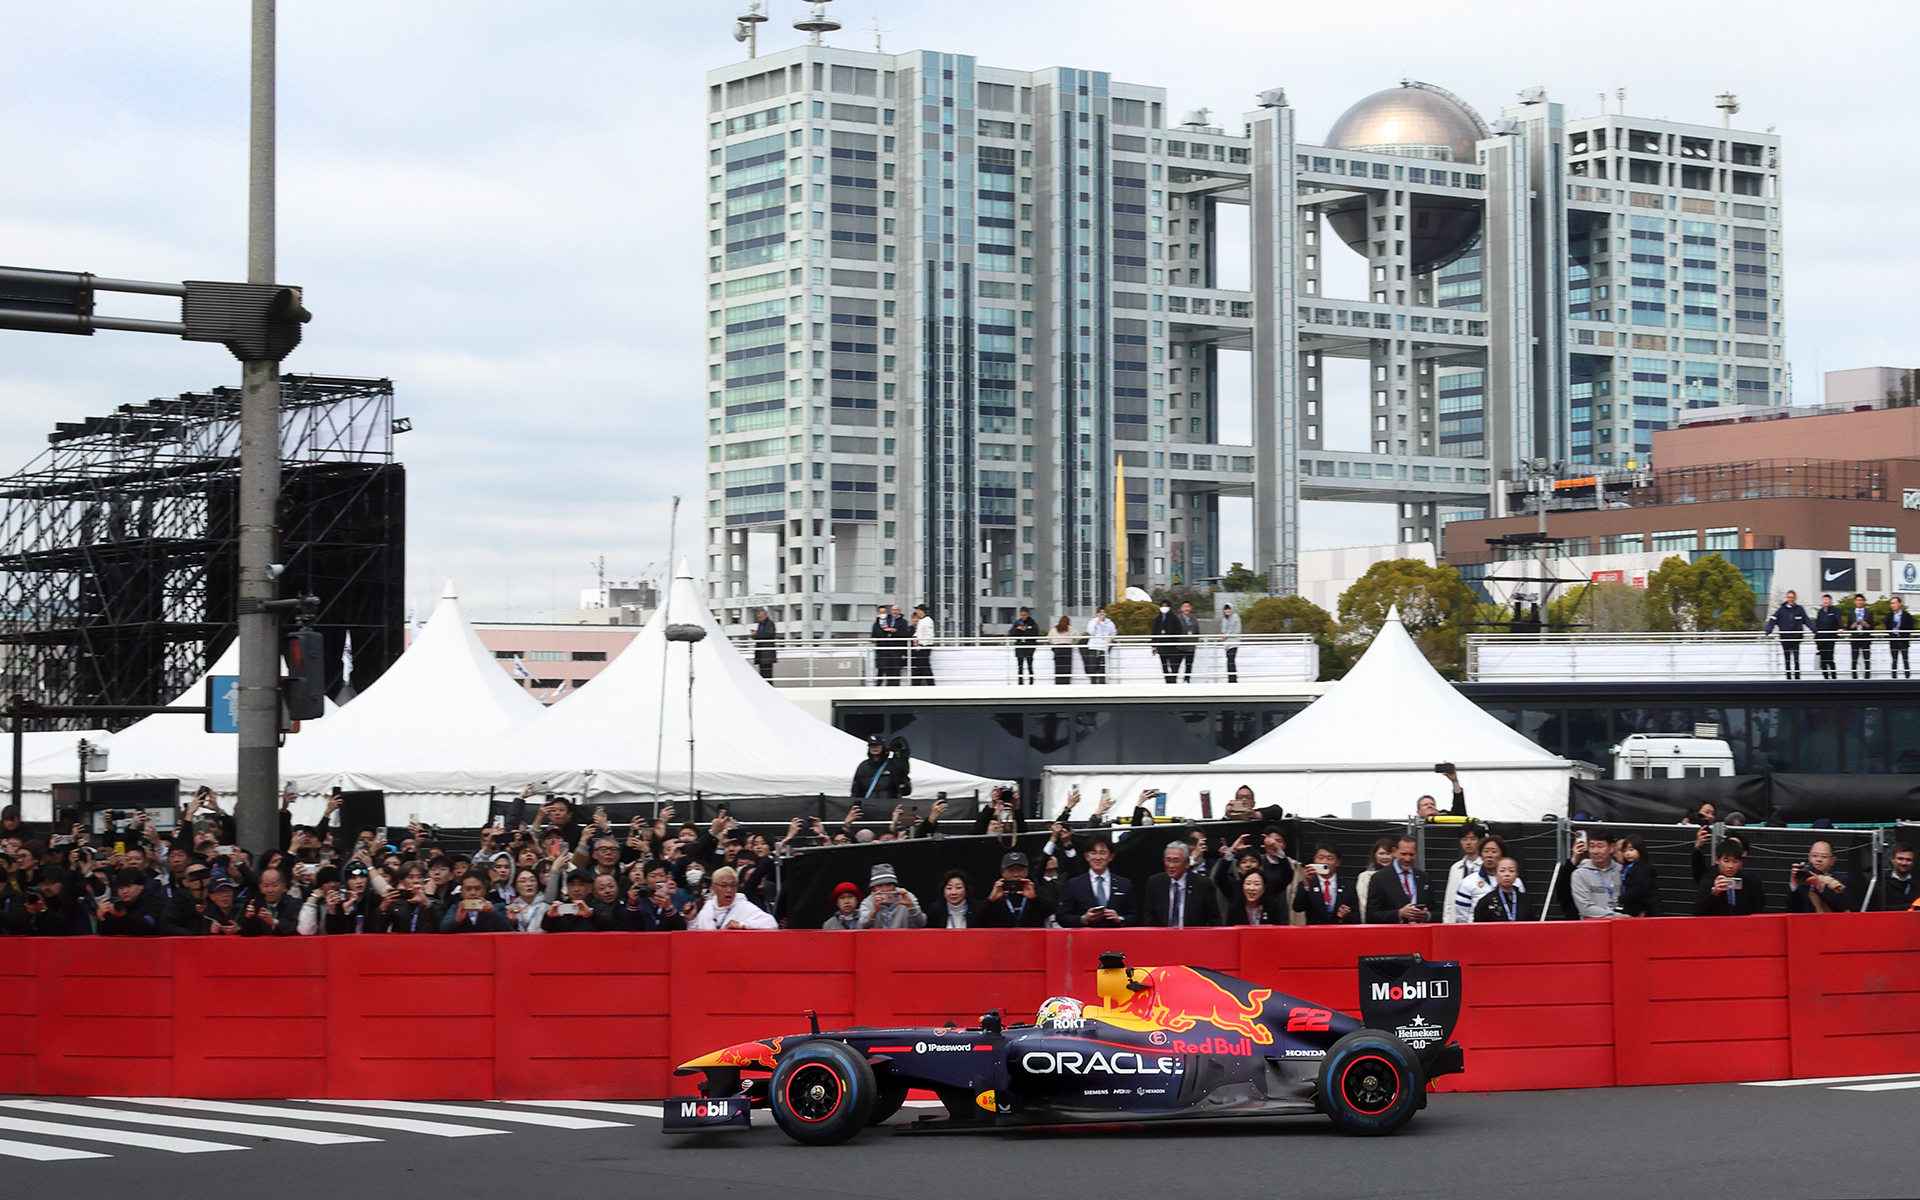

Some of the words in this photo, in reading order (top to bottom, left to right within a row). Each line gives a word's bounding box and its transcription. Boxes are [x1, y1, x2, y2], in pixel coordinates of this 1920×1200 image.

[1371, 981, 1427, 1000] Mobil
[1053, 1019, 1087, 1029] ROKT
[1287, 1007, 1333, 1032] 22
[1398, 1029, 1440, 1038] Heineken
[928, 1043, 971, 1052] 1Password
[1172, 1038, 1211, 1054] Red
[1214, 1038, 1252, 1056] Bull
[1285, 1049, 1327, 1057] HONDA
[1022, 1051, 1184, 1075] ORACLE
[681, 1101, 728, 1117] Mobil
